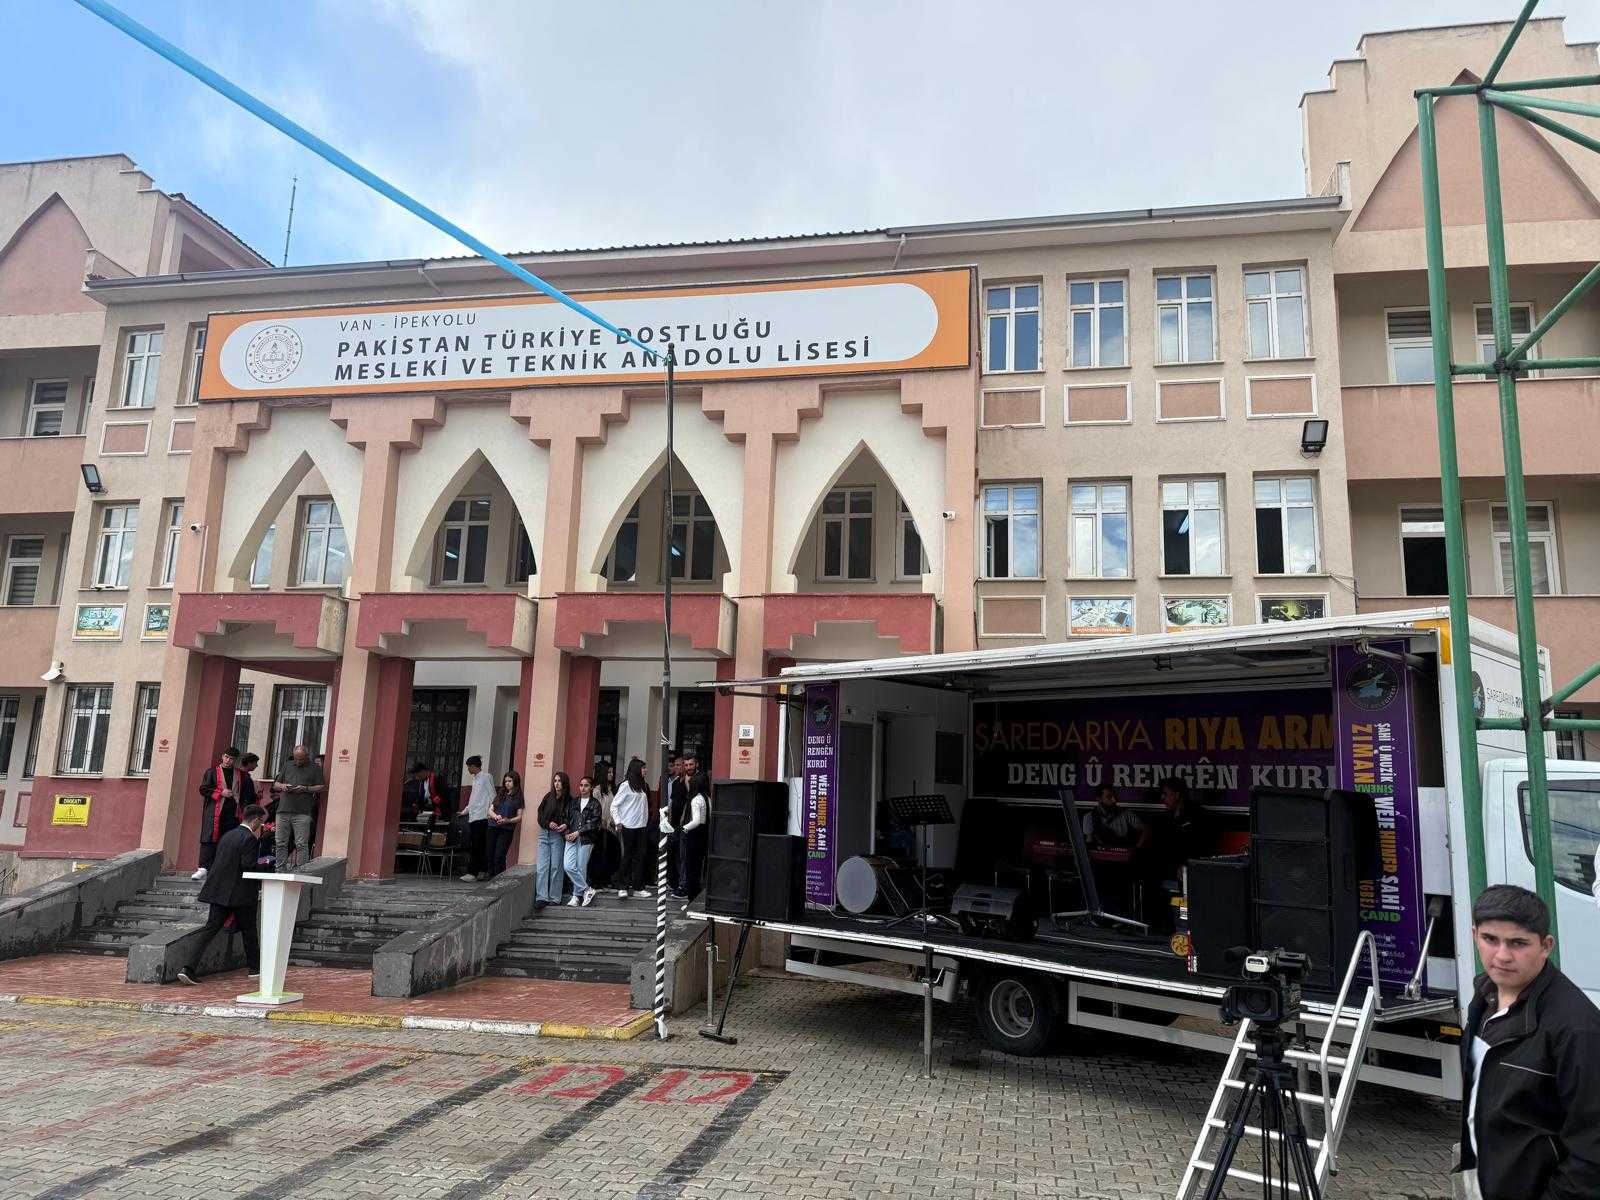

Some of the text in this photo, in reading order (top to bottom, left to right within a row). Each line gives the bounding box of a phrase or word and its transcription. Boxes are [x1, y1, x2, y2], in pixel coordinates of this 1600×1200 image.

[337, 318, 772, 358] PAKİSTAN TÜRKİYE DOSTLUĞU
[340, 319, 372, 332] VAN
[394, 313, 477, 329] İPEKYOLU
[335, 335, 870, 381] MESLEKİ VE TEKNİK ANADOLU LİSESİ
[807, 736, 825, 744] DENG
[1165, 716, 1245, 750] RIYA
[1351, 723, 1375, 784] ZIMAN
[1008, 762, 1076, 785] DENG
[1085, 756, 1103, 786] Û
[1112, 758, 1239, 789] RENGÊN
[809, 774, 817, 811] HELBEST
